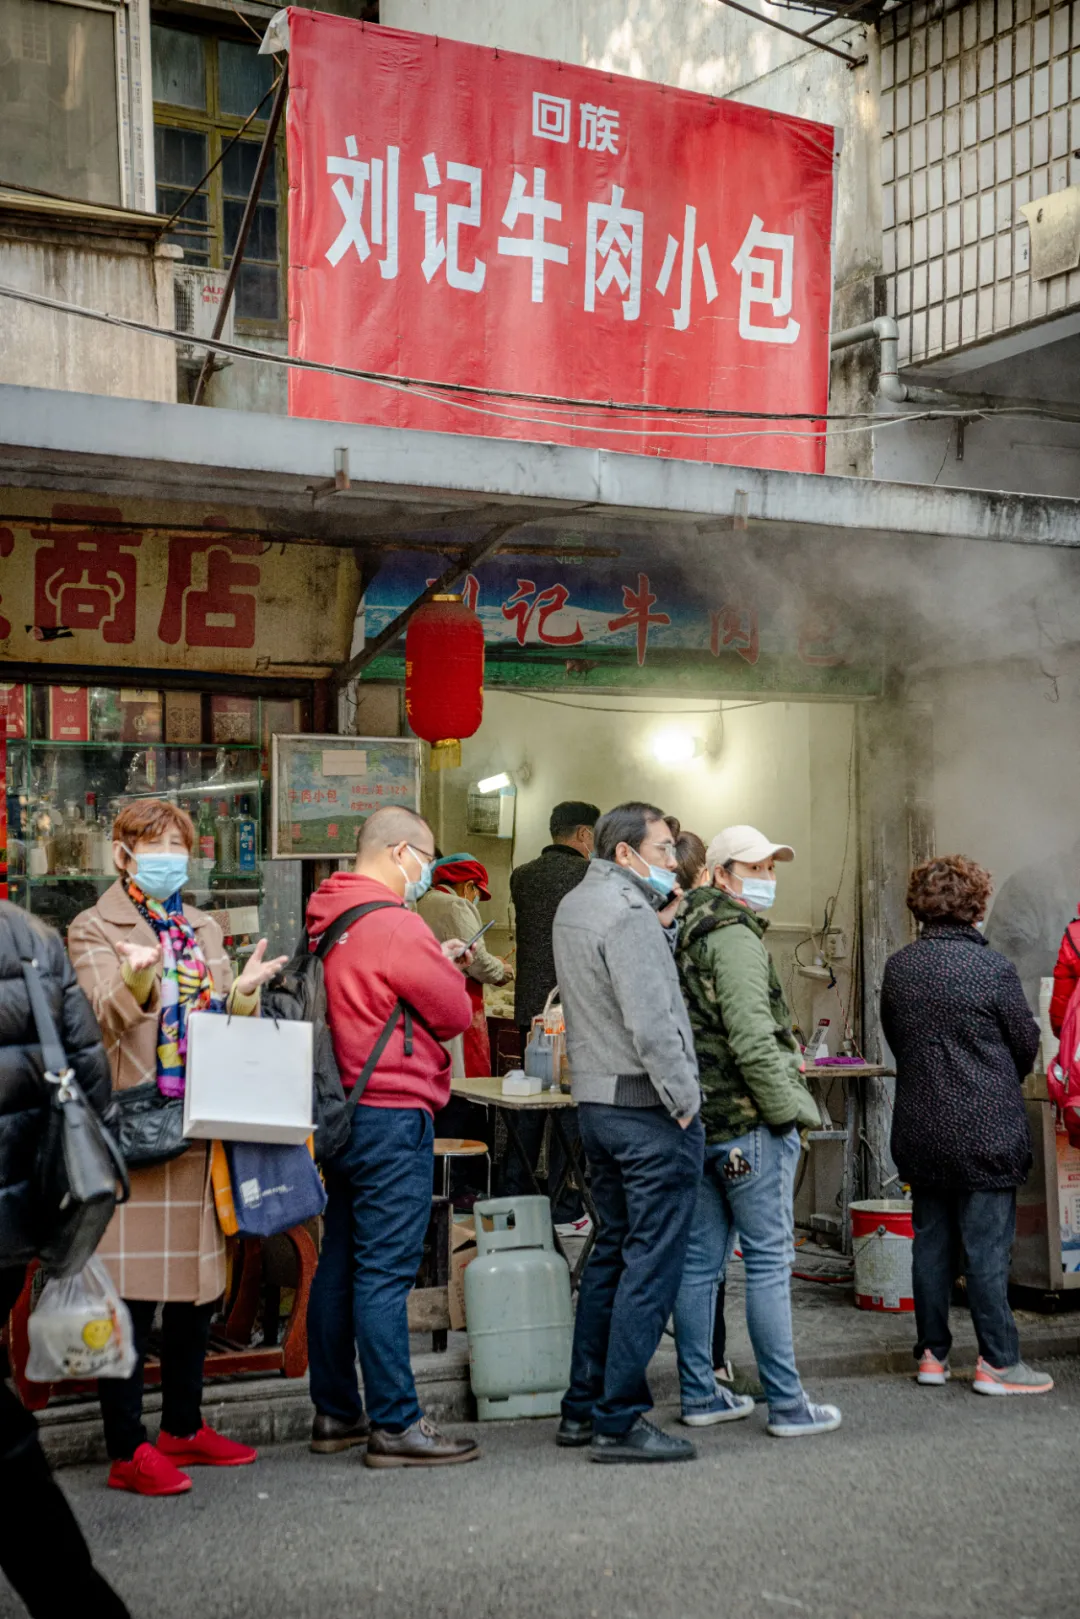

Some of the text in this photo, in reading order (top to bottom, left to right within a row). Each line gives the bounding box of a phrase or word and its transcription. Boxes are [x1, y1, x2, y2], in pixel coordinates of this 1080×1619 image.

[532, 91, 620, 155] 回族
[324, 134, 801, 344] 刘记牛肉小包
